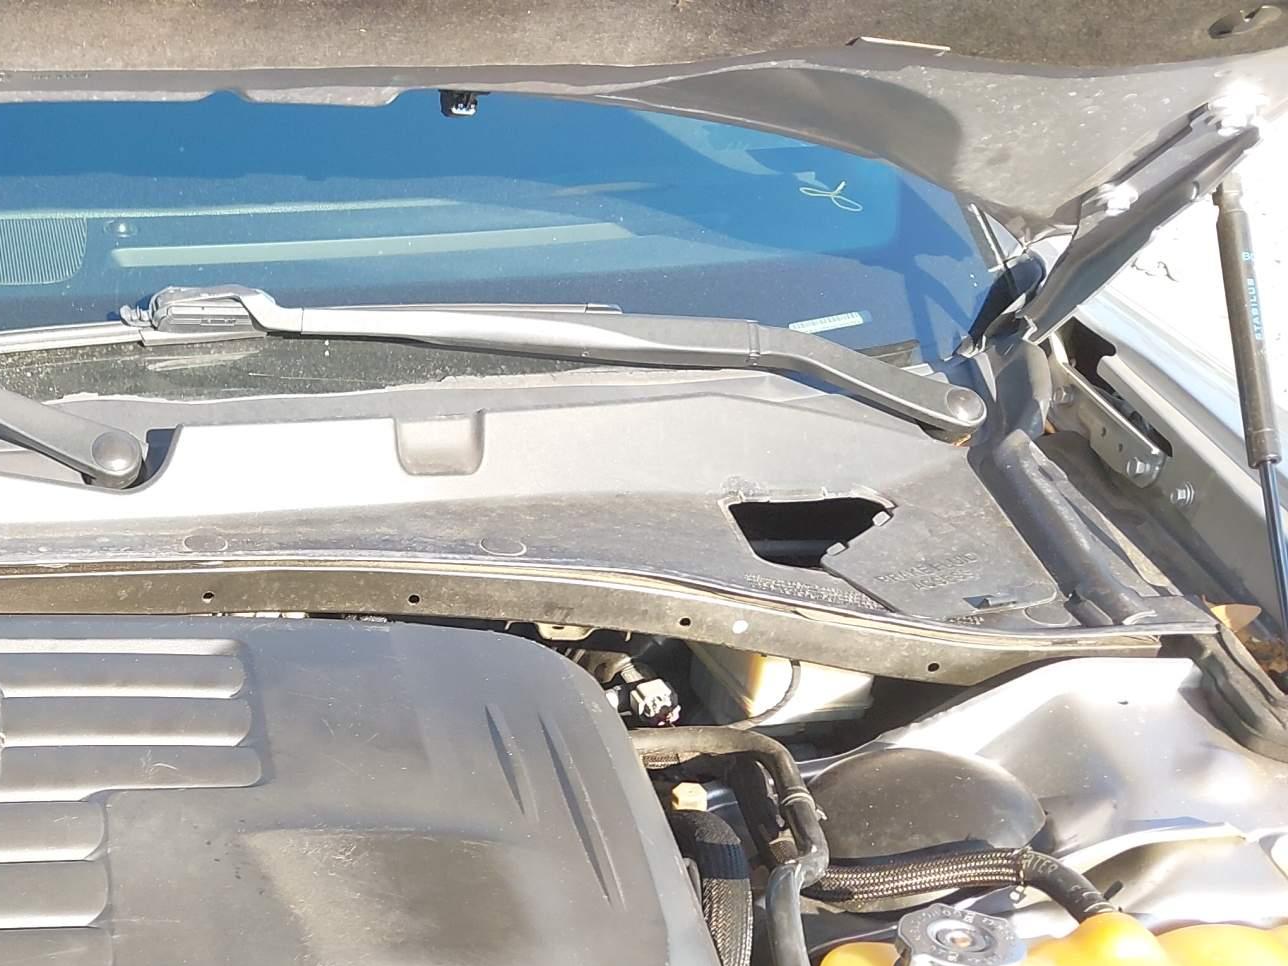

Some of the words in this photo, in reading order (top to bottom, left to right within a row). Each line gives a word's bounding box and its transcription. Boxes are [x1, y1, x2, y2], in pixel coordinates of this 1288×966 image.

[874, 563, 935, 583] BRAKE
[933, 552, 978, 574] FLUID
[912, 569, 974, 591] ACCESS
